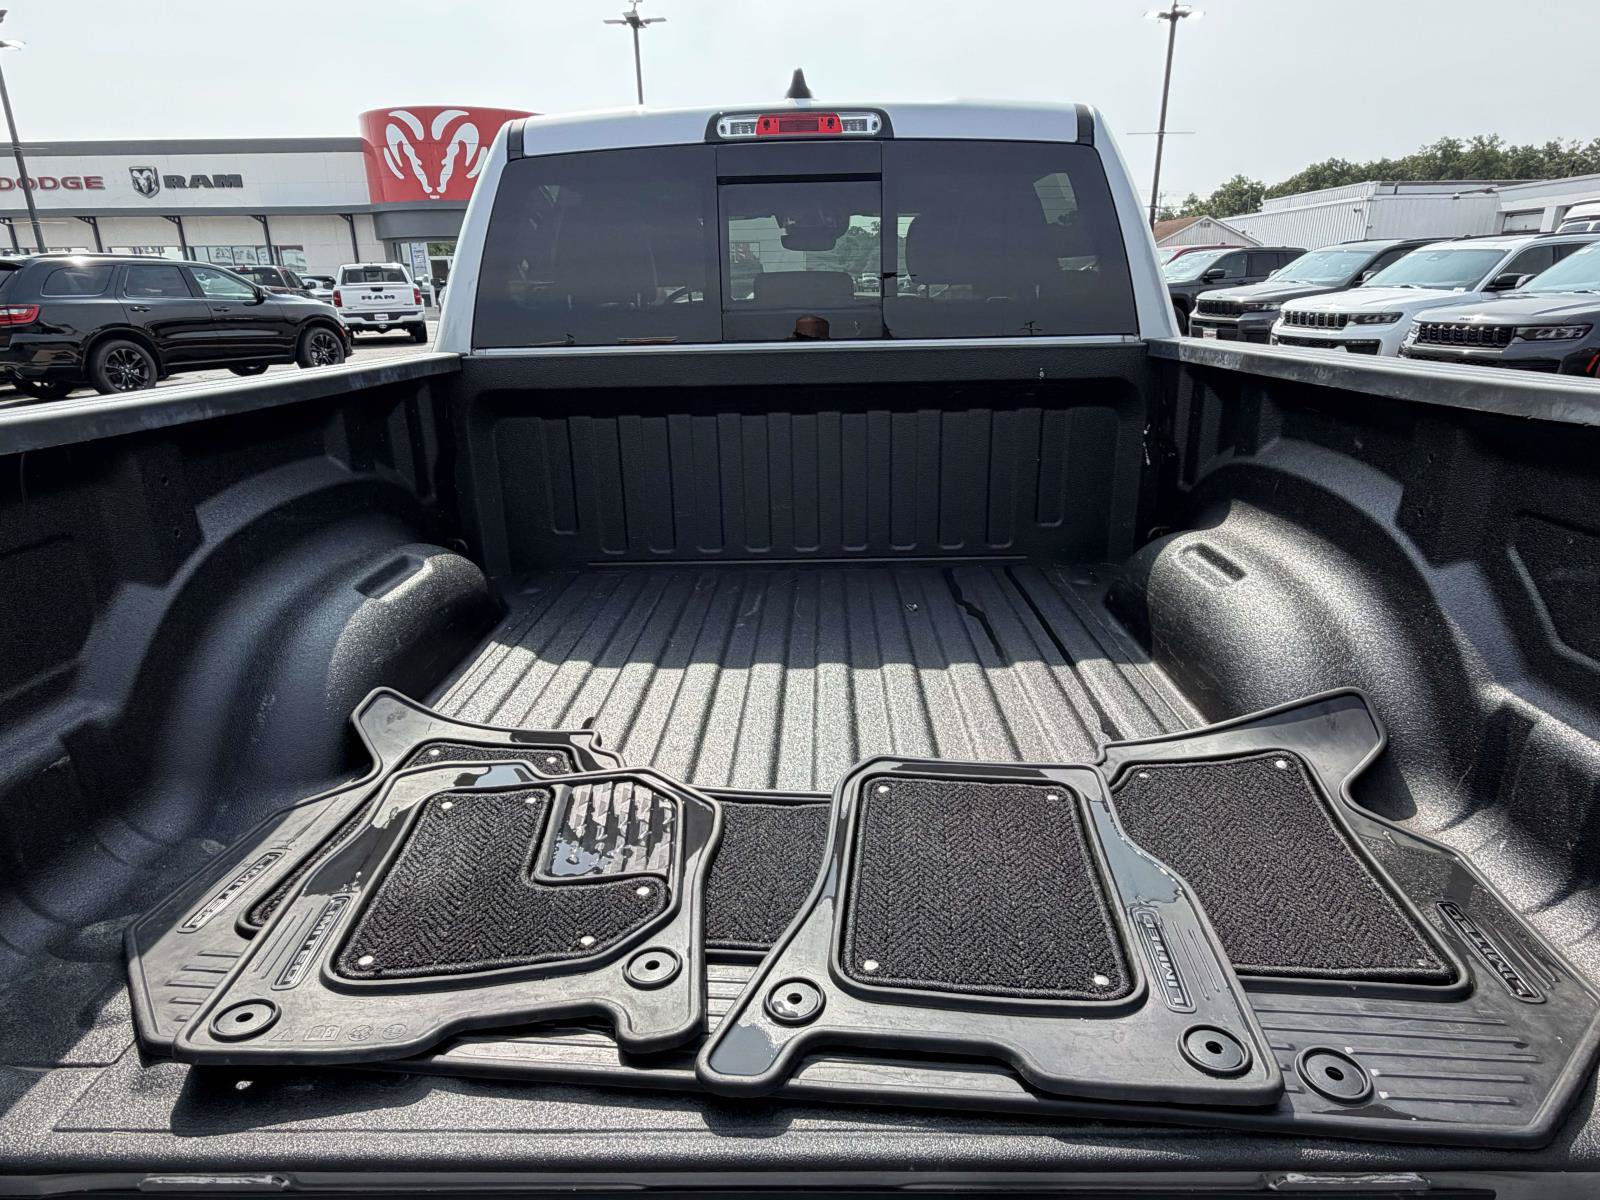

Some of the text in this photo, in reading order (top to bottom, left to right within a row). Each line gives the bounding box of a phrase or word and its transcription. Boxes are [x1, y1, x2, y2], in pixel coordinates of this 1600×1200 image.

[0, 176, 105, 191] DODGE
[163, 174, 243, 189] RAM
[283, 899, 345, 983] LIMITED
[1142, 913, 1186, 1005] LIMITED
[1444, 905, 1534, 997] LIMITED
